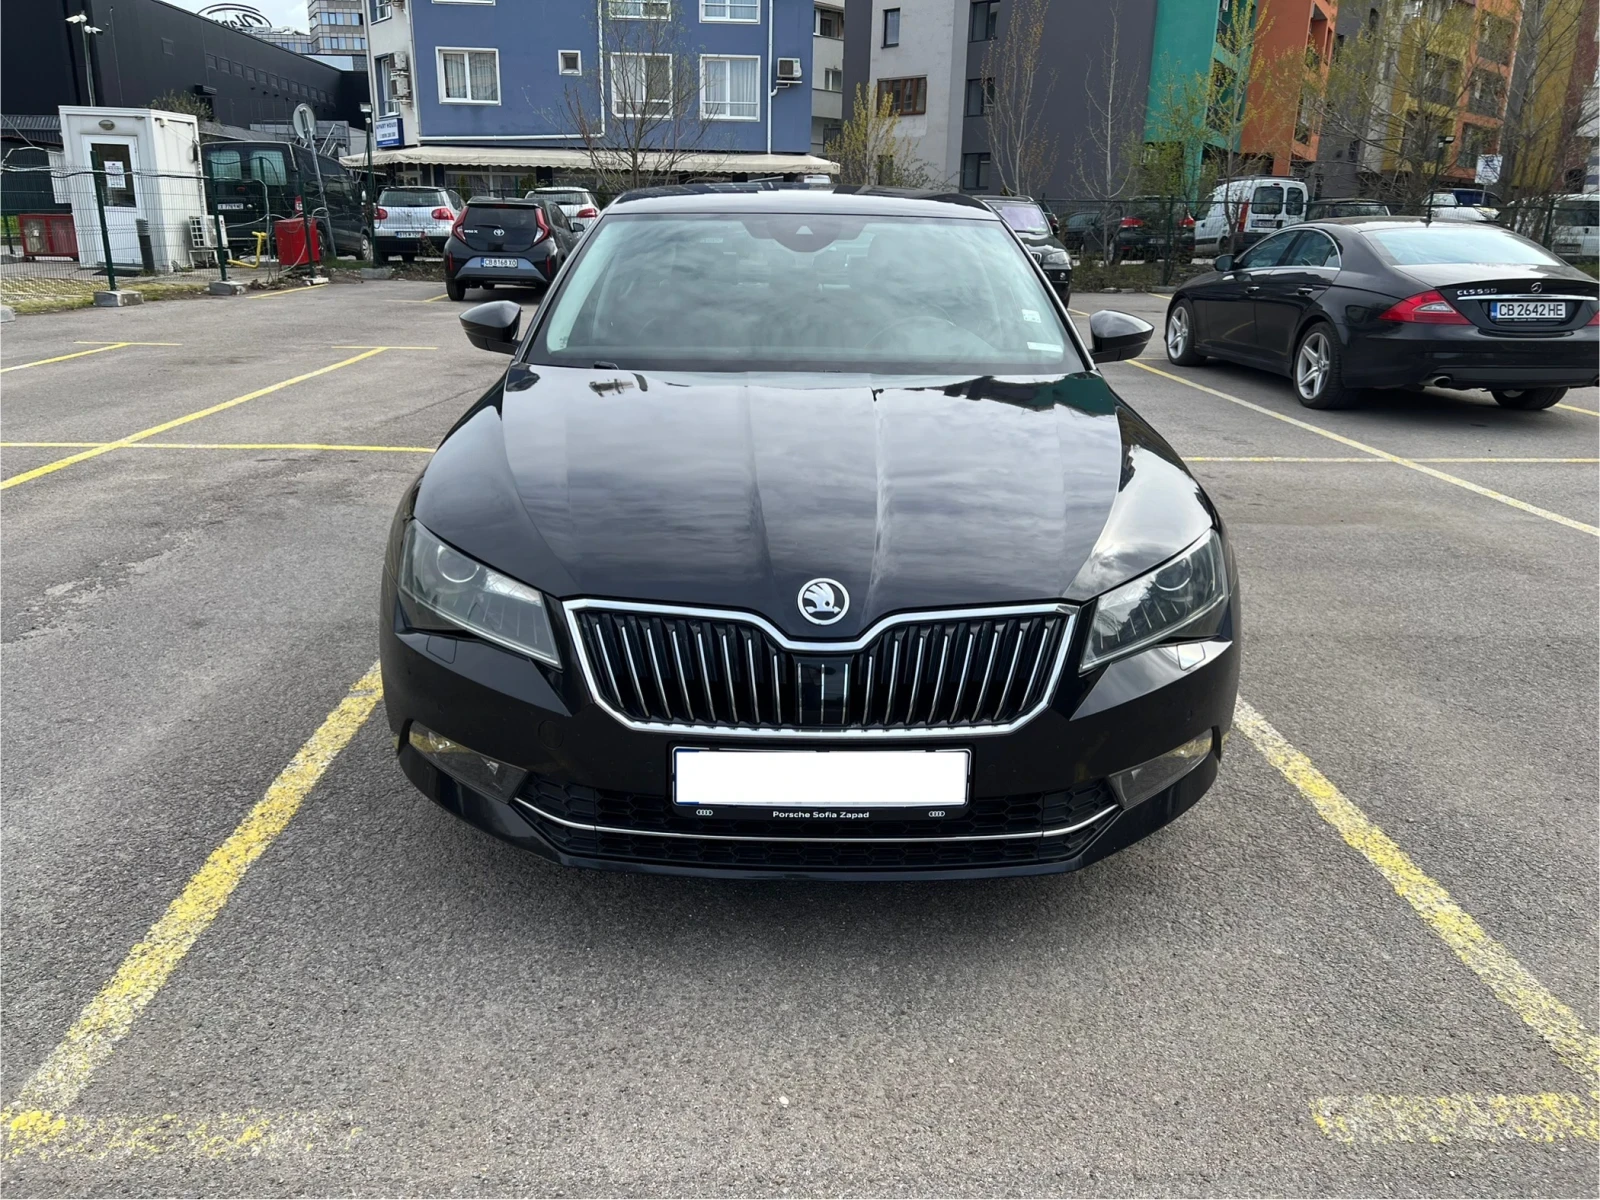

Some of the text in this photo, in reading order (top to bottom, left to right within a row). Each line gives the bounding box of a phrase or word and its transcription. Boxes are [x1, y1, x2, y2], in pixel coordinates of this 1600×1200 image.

[1499, 304, 1563, 316] CB 2642 HE
[839, 811, 870, 819] Zapad
